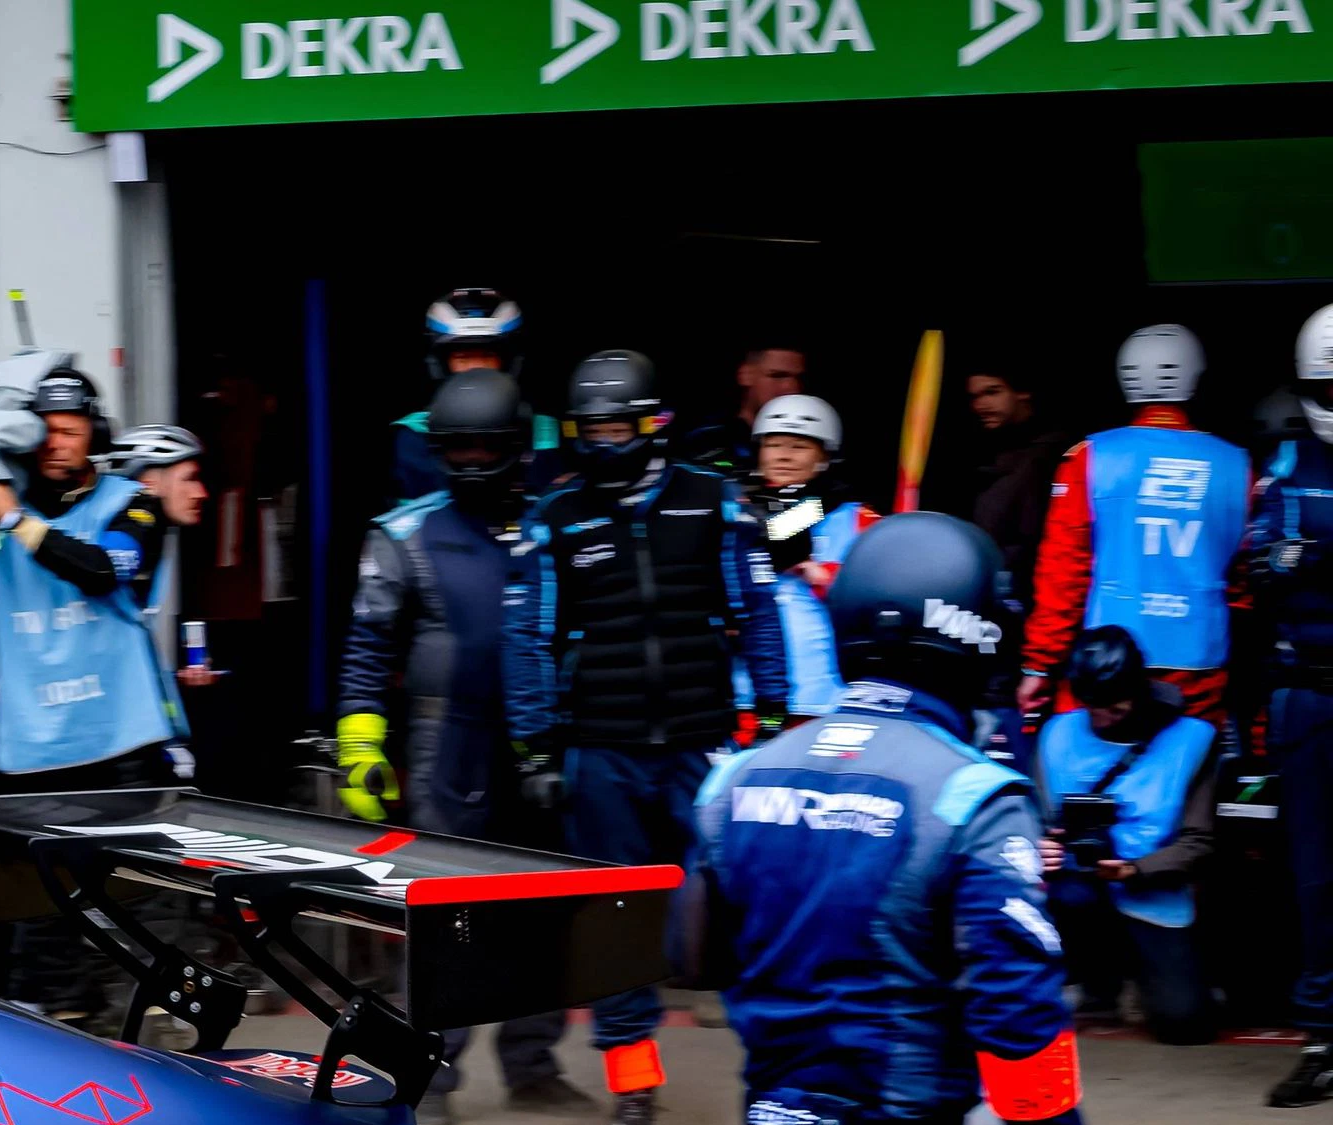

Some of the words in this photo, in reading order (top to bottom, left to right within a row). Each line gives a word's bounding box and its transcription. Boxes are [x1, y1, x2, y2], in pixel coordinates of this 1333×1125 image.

[242, 13, 463, 80] DEKRA
[639, 0, 876, 61] DEKRA
[1135, 517, 1204, 558] TV
